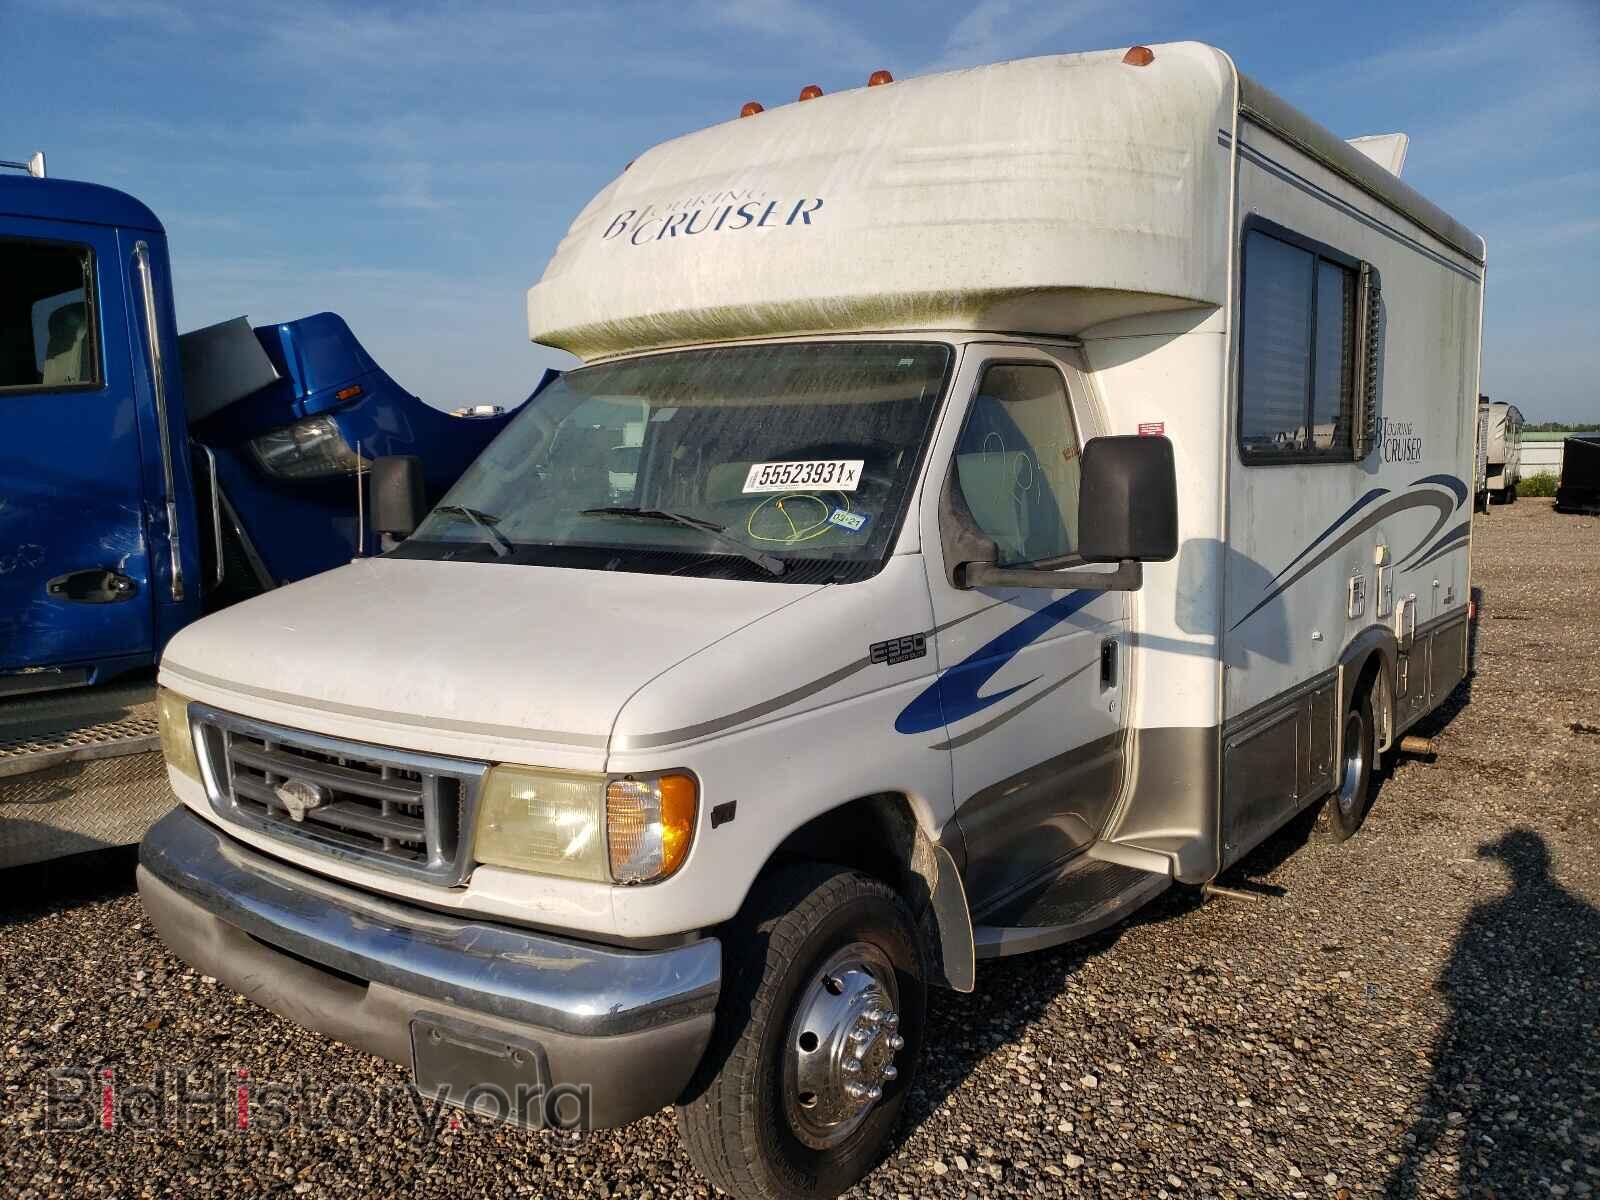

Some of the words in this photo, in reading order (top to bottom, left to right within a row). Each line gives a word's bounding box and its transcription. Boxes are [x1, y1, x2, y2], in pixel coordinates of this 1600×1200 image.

[631, 198, 824, 246] CRUISER
[1384, 438, 1422, 463] CRUISER
[870, 634, 926, 663] E350
